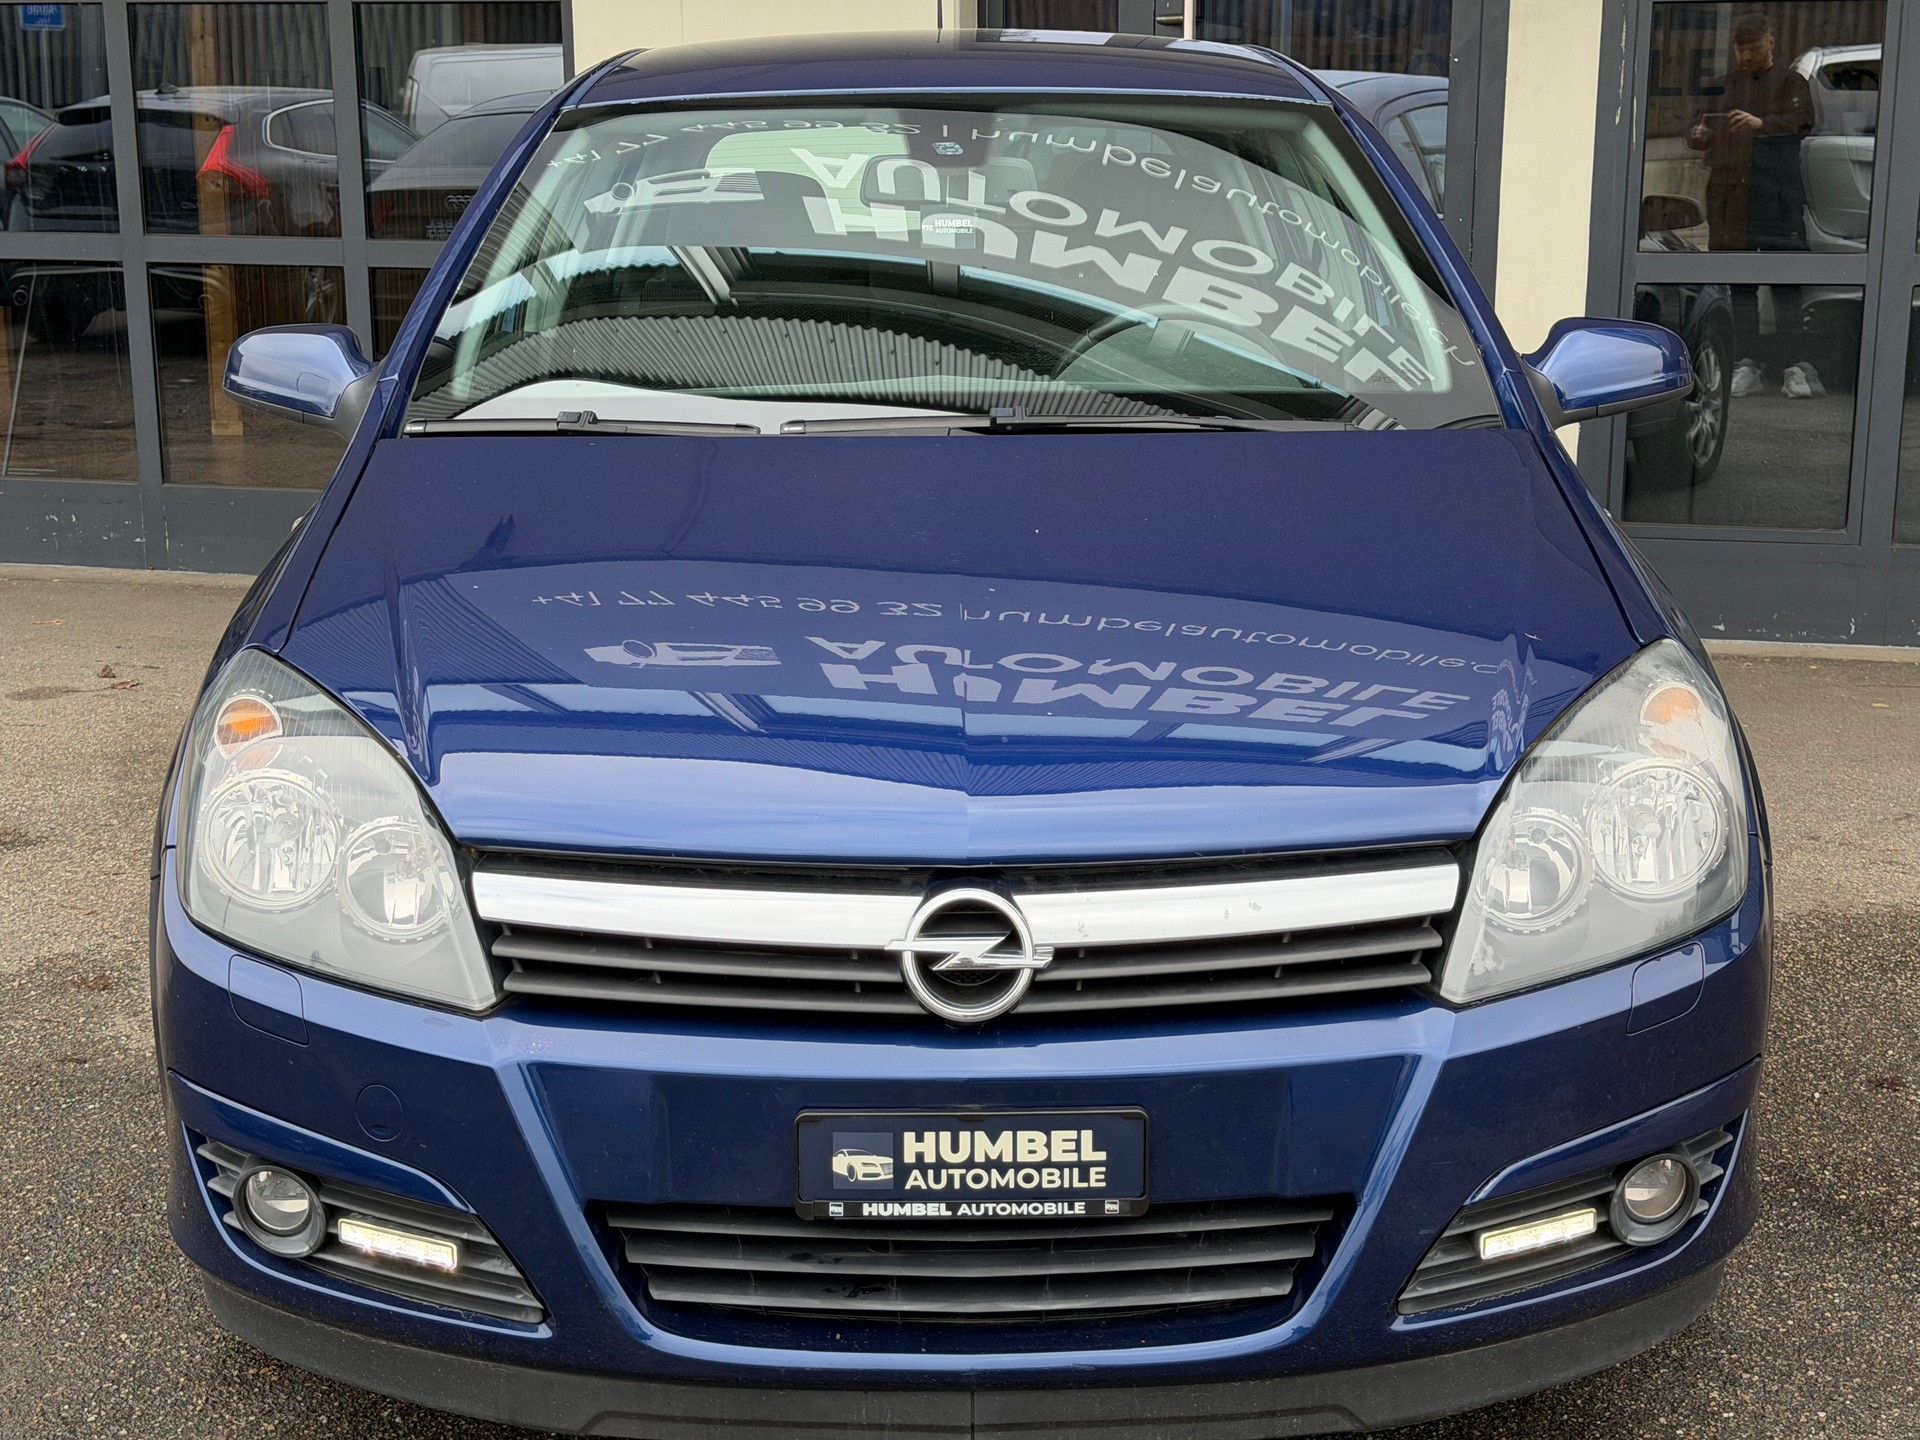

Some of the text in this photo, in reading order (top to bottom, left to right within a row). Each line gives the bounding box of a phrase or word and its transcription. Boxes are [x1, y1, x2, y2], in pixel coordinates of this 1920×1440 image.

[934, 219, 974, 227] HUMBEL
[903, 1129, 1107, 1163] HUMBEL
[904, 1166, 1107, 1190] AUTOMOBILE
[862, 1201, 1086, 1216] HUMBEL AUTOMOBILE
